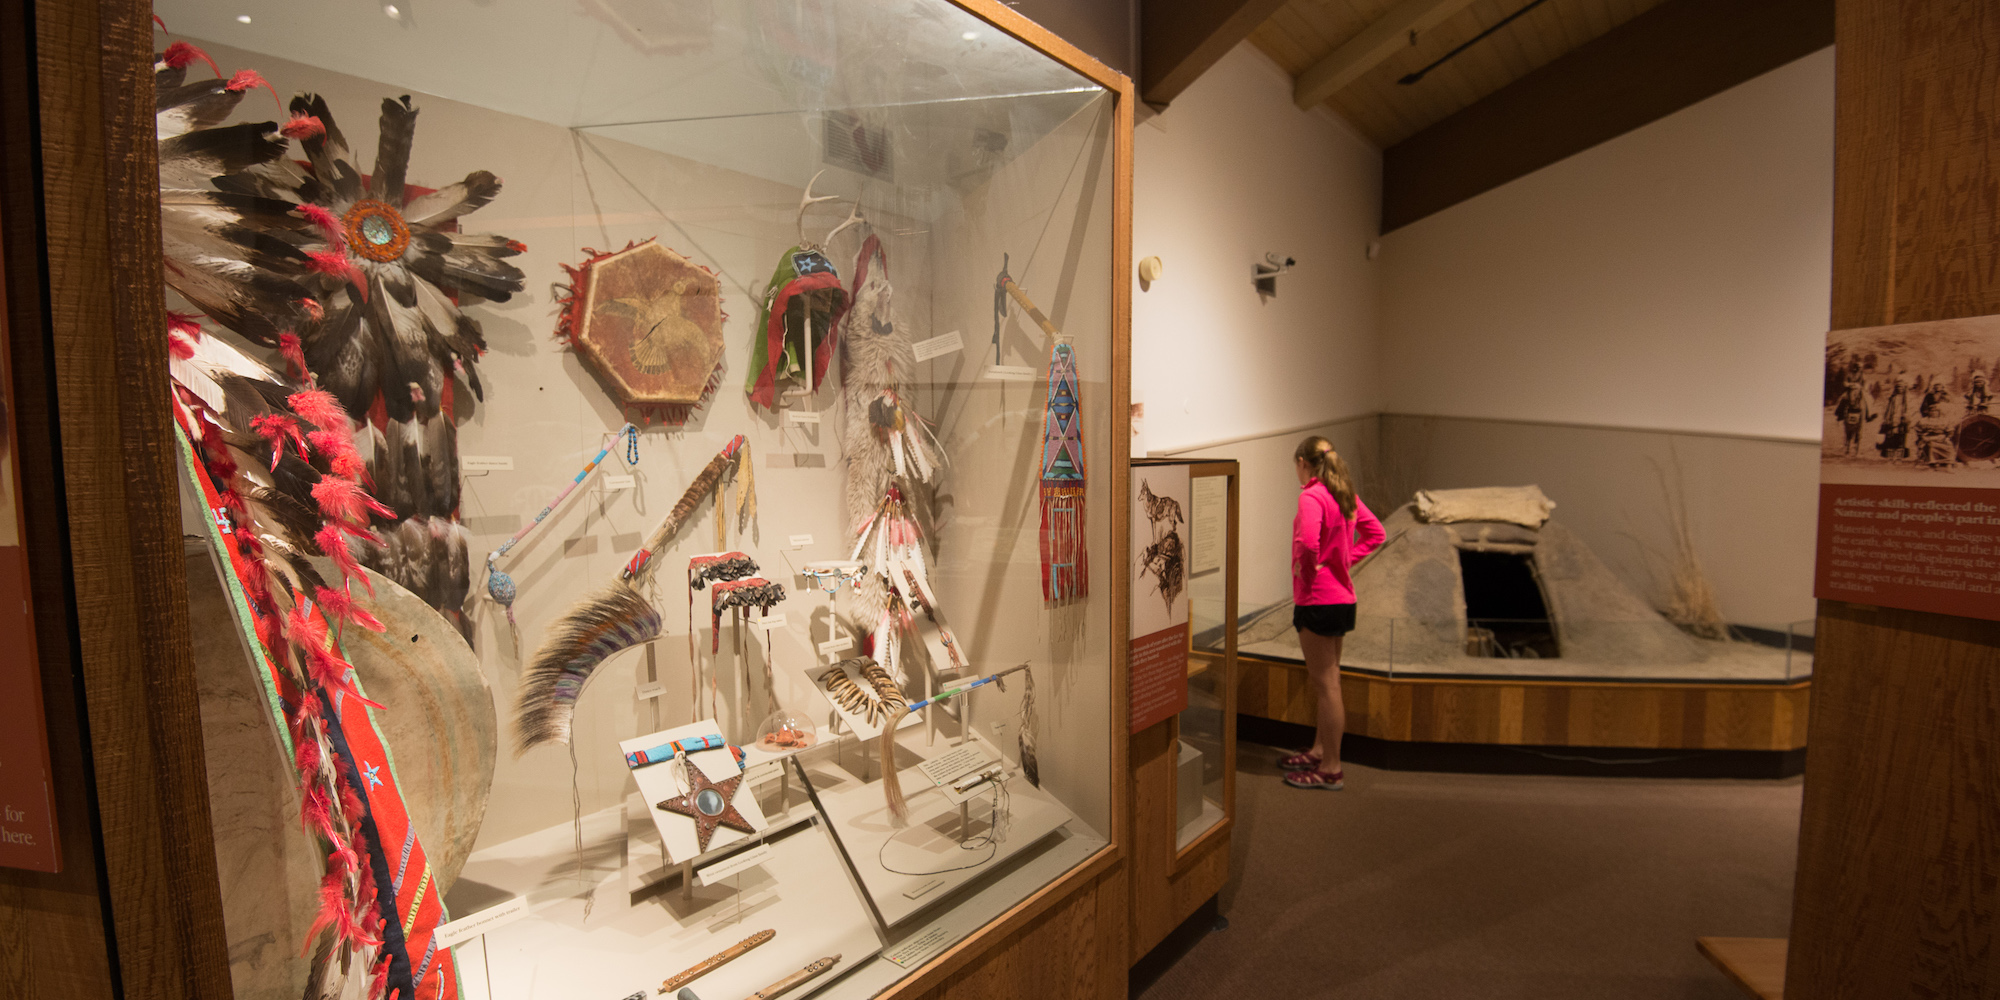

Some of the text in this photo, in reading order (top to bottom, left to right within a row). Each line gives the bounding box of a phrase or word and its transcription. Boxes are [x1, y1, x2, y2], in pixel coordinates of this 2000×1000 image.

[1834, 497, 1997, 513] Artistic skills reflected the
[1834, 508, 1874, 519] Nature
[1876, 509, 1899, 520] and
[1901, 513, 1954, 524] people's
[1956, 514, 1984, 526] part
[1832, 535, 1850, 545] the
[1946, 544, 1968, 554] and
[1970, 545, 1991, 556] the
[1923, 530, 1945, 540] and
[1947, 532, 1993, 546] designs
[1832, 546, 1867, 558] People
[1914, 552, 1974, 567] displaying
[1976, 556, 1996, 568] the
[1862, 560, 1882, 570] and
[1924, 566, 1962, 580] Finery
[1964, 571, 1988, 580] was
[1892, 576, 1906, 586] of
[1916, 577, 1966, 590] beautiful
[1968, 583, 1992, 594] and
[4, 804, 25, 822] for
[1, 824, 36, 846] here.
[444, 928, 458, 939] Eagle
[458, 922, 476, 934] feather
[476, 917, 494, 926] bonnet
